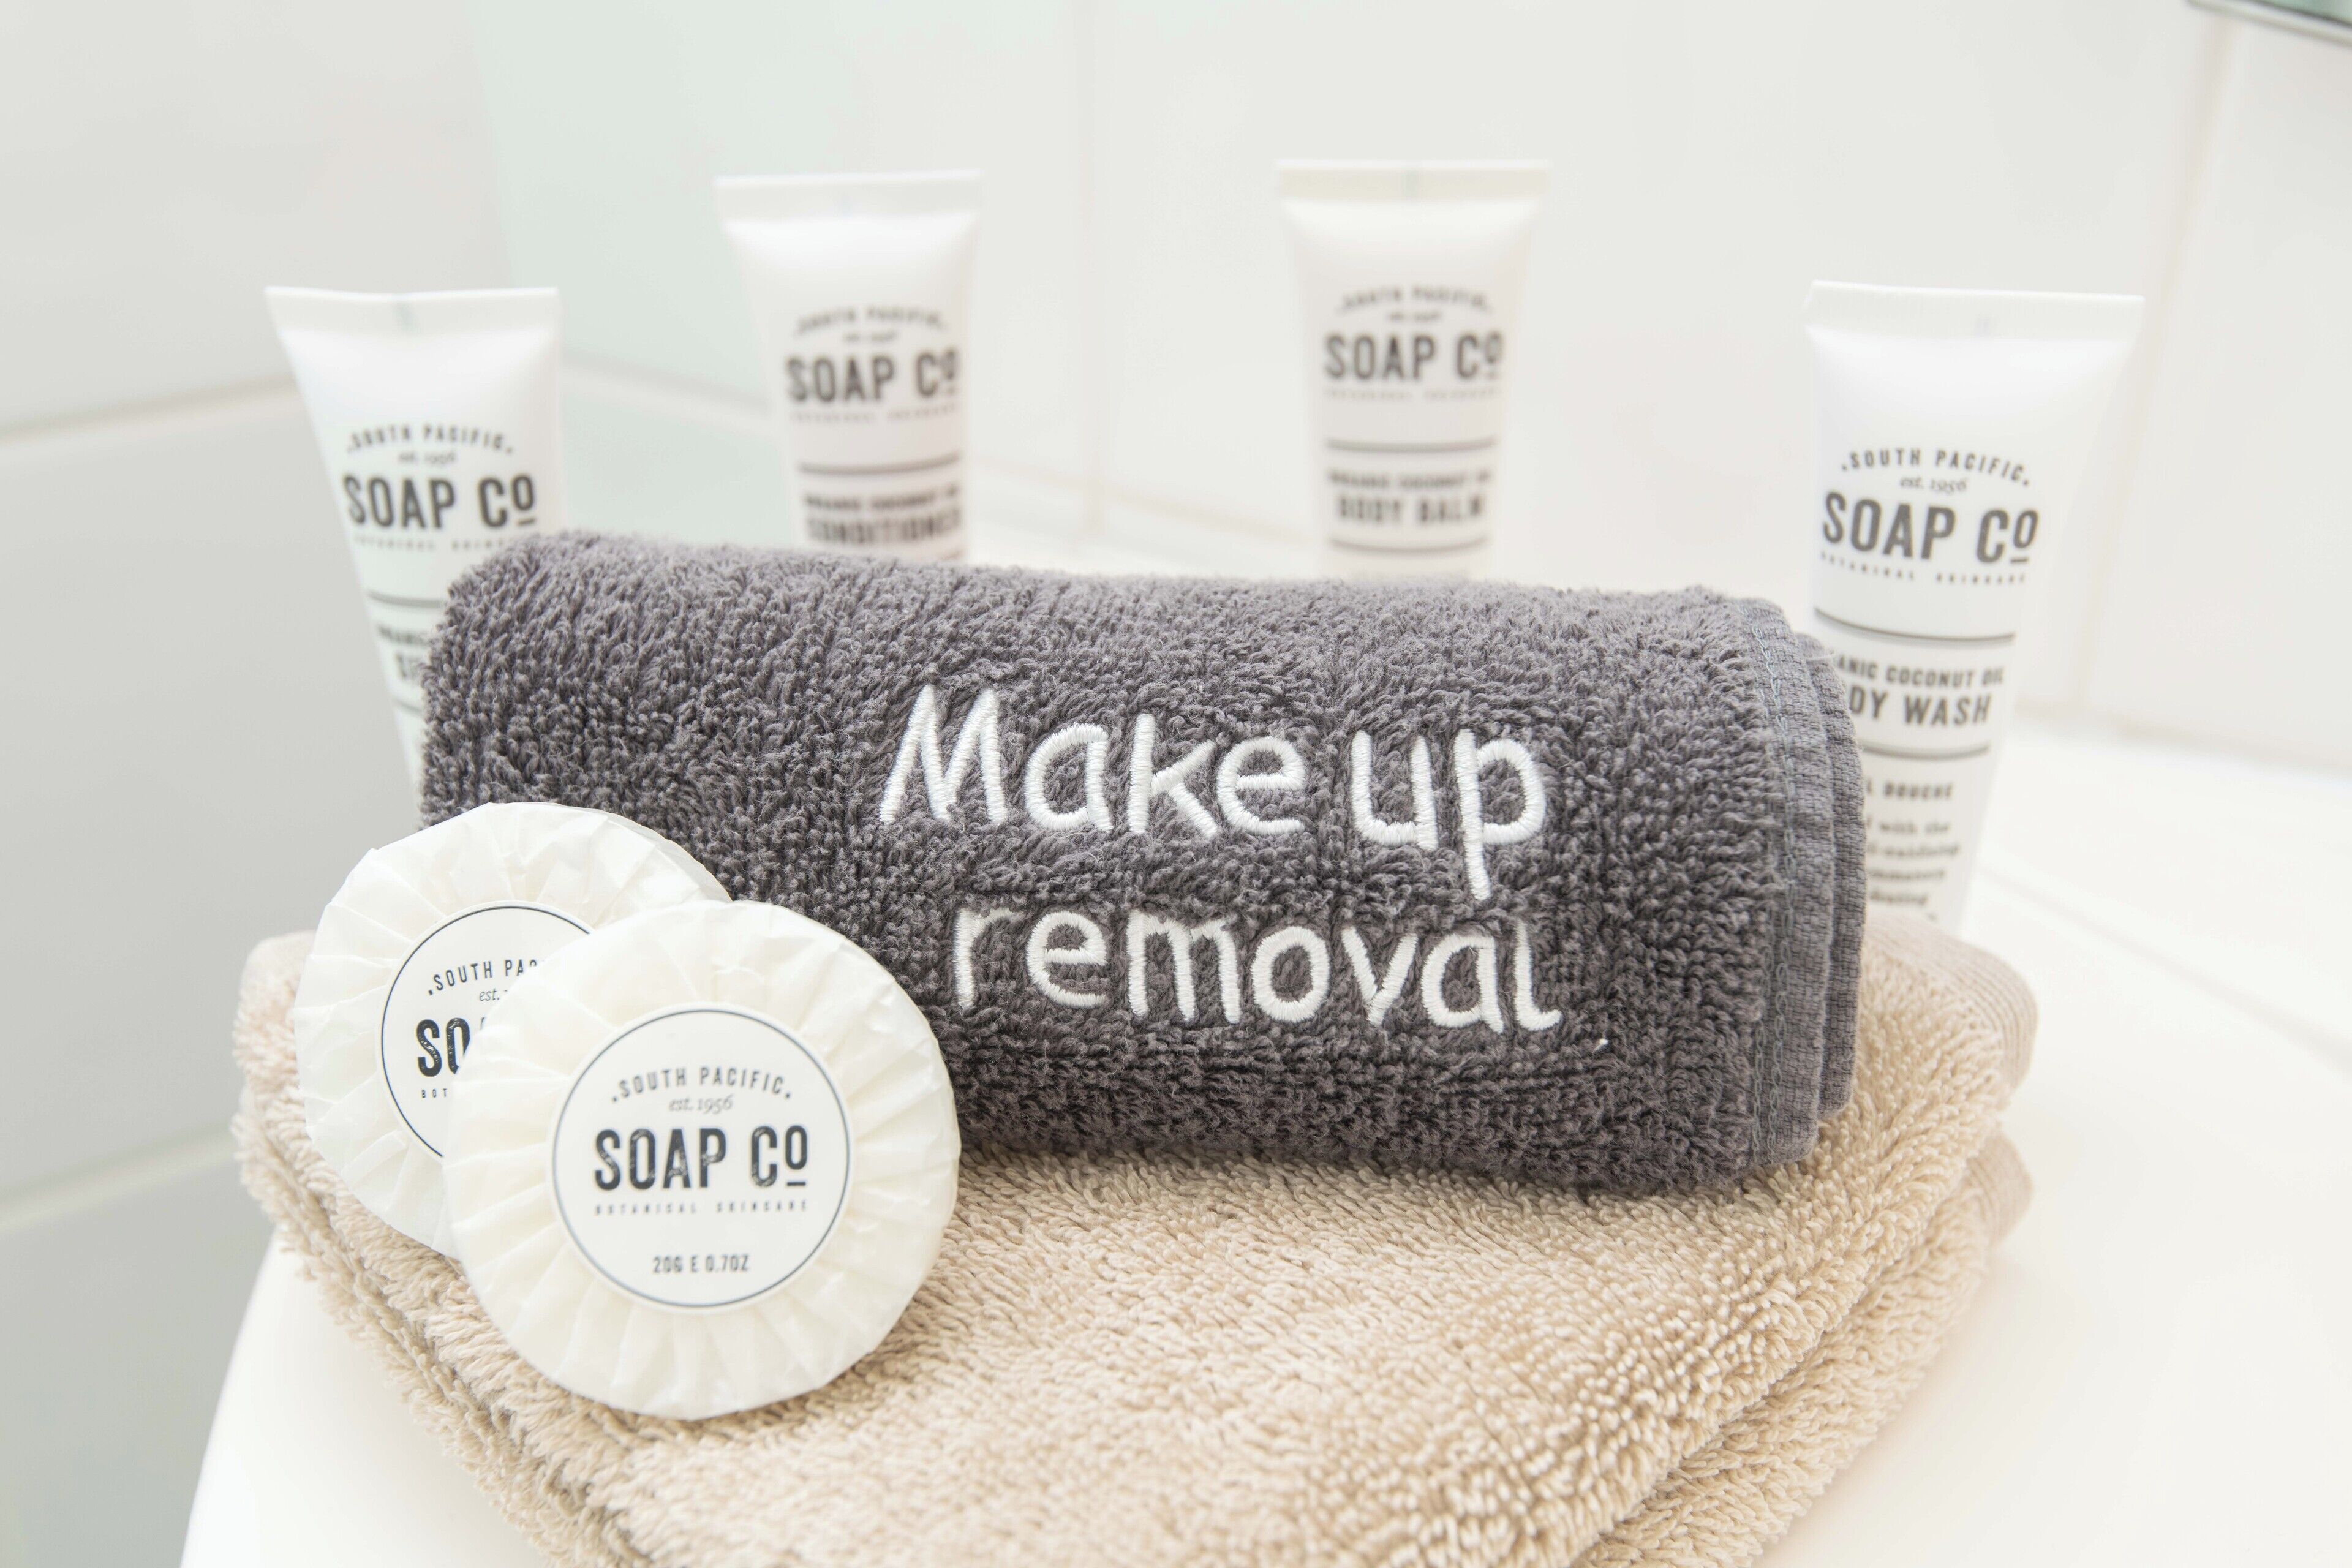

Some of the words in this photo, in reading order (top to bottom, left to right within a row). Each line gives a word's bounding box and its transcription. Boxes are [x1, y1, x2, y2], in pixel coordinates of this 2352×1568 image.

[786, 354, 894, 403] SOAP
[1325, 332, 1436, 380] SOAP
[1850, 448, 1921, 469] SOUTH
[1935, 450, 2024, 481] PACIFIC
[343, 473, 456, 529] SOAP
[1823, 491, 1956, 560] SOAP
[1838, 654, 1877, 679] ANIC
[1849, 687, 1889, 719] DY
[1905, 694, 1991, 727] WASH
[878, 684, 1309, 838] Make
[1350, 728, 1546, 899] up
[433, 960, 493, 991] SOUTH
[952, 909, 1563, 1033] removal
[417, 1017, 471, 1078] SO
[619, 1068, 687, 1098] SOUTH
[700, 1067, 786, 1095] PACIFIC
[669, 1098, 693, 1111] est.
[697, 1095, 734, 1115] 1956
[595, 1128, 727, 1191] SOAP
